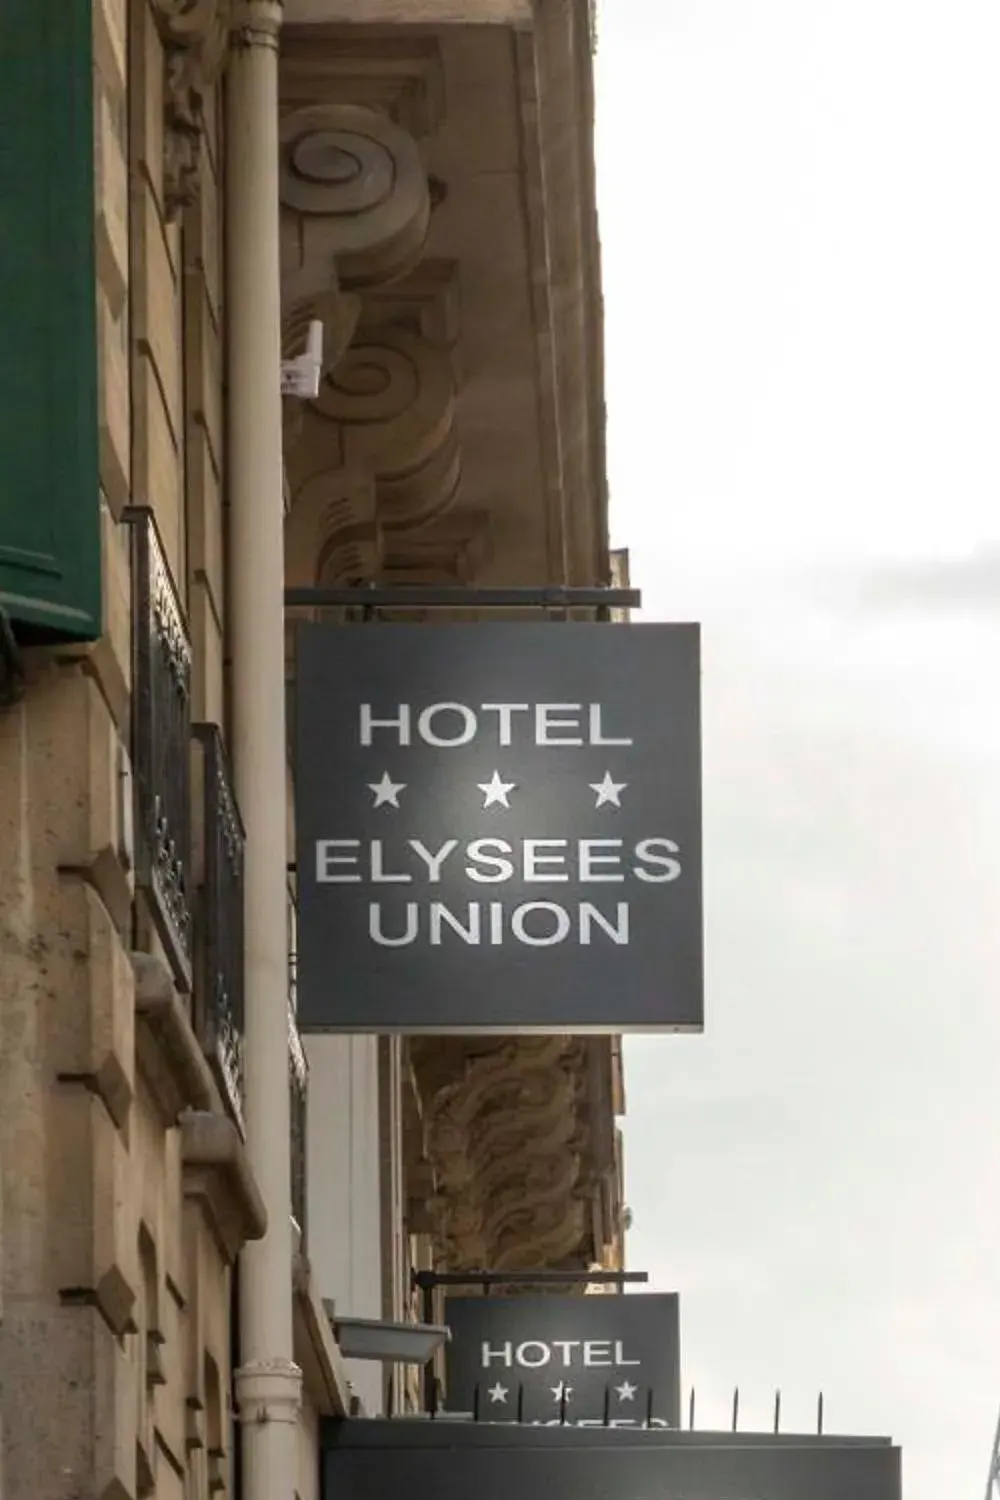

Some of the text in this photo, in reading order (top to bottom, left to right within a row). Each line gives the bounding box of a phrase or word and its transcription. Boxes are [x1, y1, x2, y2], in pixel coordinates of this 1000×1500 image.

[359, 702, 633, 747] HOTEL
[315, 838, 683, 884] ELYSEES
[368, 901, 631, 947] UNION
[481, 1340, 641, 1368] HOTEL
